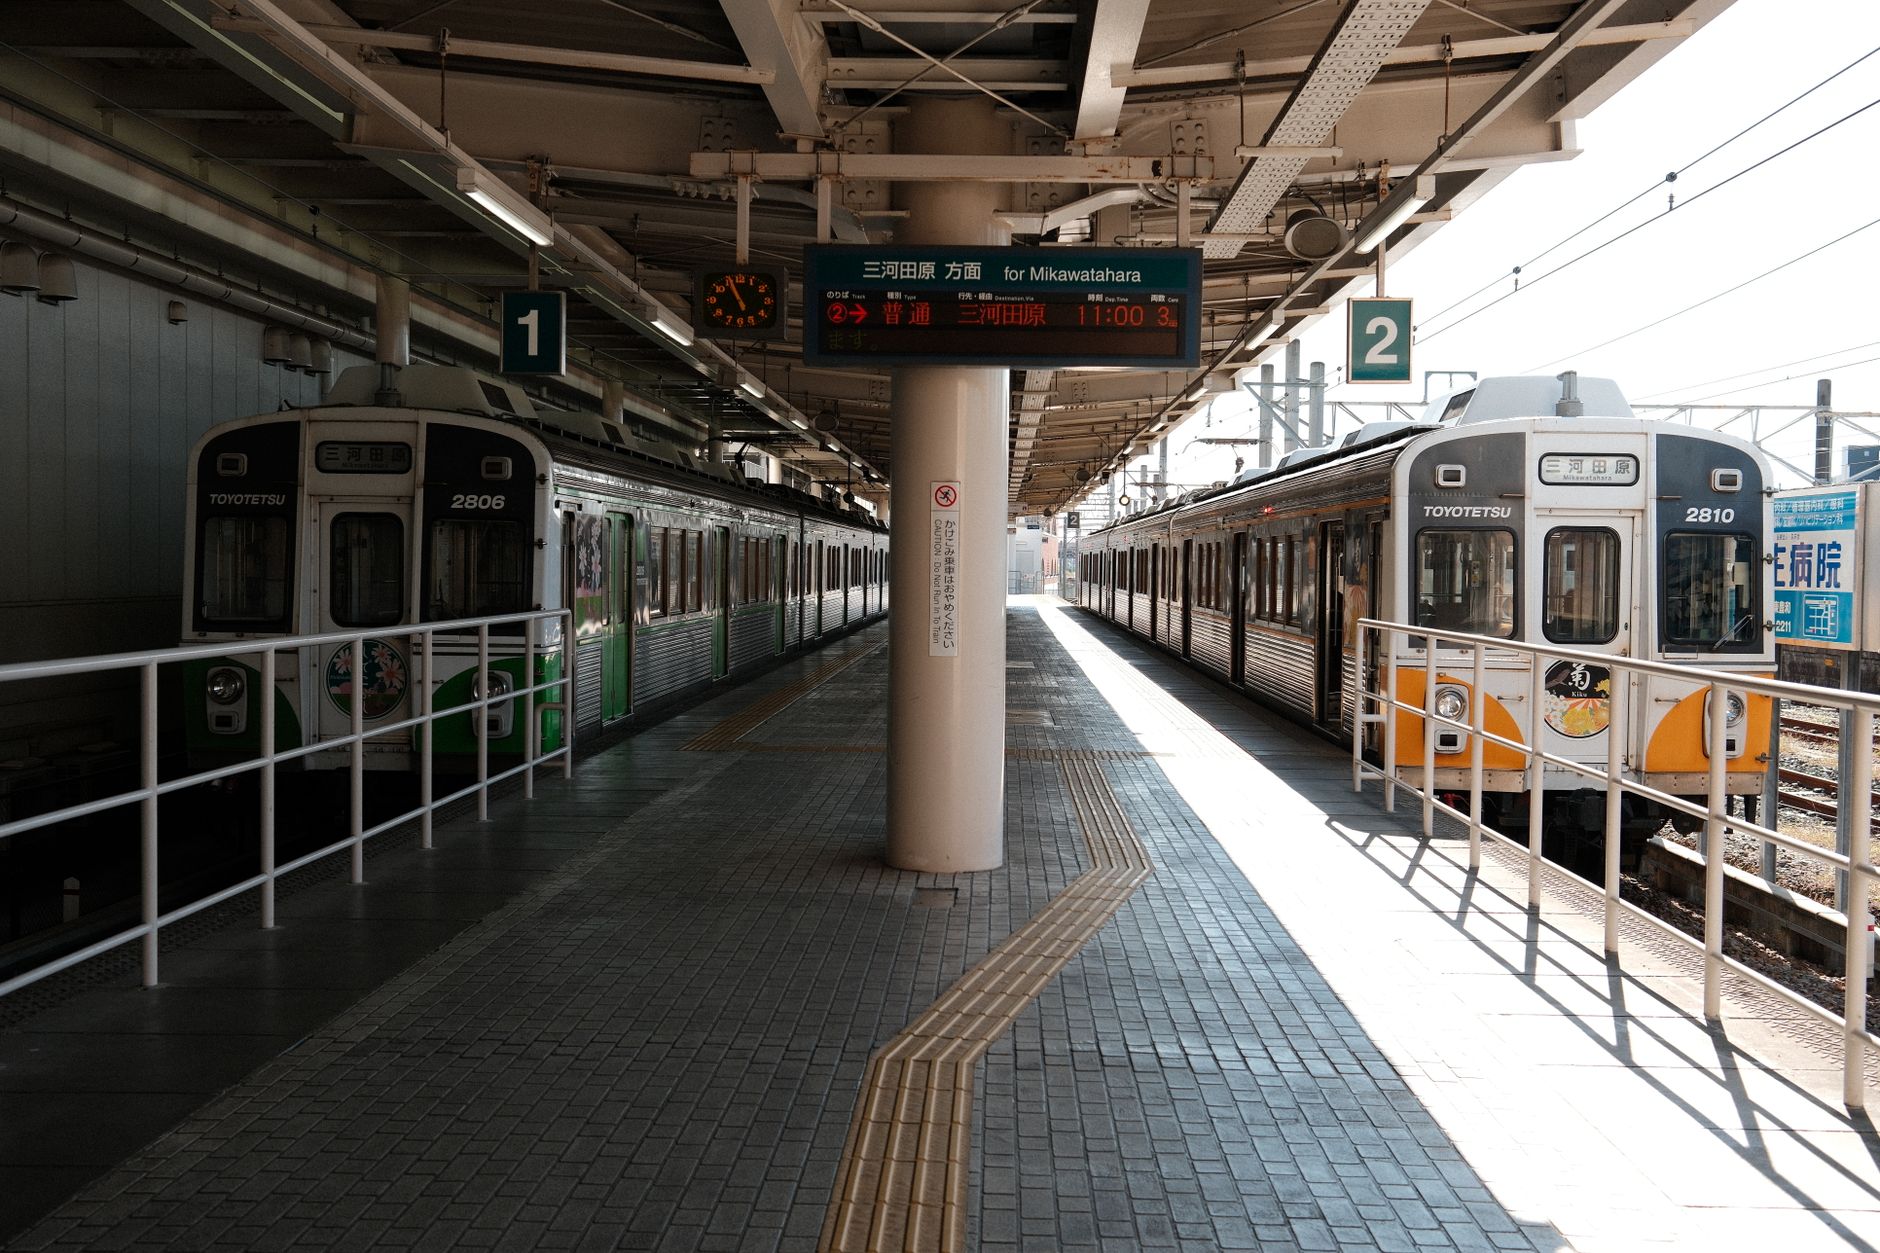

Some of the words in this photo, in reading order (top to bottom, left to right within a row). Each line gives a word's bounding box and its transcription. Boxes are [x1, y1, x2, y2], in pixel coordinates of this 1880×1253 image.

[862, 261, 936, 280] 三河田原
[944, 261, 982, 280] 方面
[1004, 266, 1025, 281] for
[1030, 266, 1141, 283] Mikawatahara
[715, 285, 726, 293] 10
[709, 296, 717, 304] 9
[764, 296, 771, 305] 3
[826, 291, 850, 300] のりば
[1088, 294, 1103, 302] 時刻
[1150, 294, 1166, 302] 両数
[715, 308, 723, 316] 8
[758, 309, 766, 318] 4
[958, 303, 1046, 326] 三河田原
[1078, 304, 1144, 326] 11:00
[726, 315, 733, 323] 7
[736, 317, 744, 326] 6
[748, 316, 756, 324] 5
[518, 309, 539, 357] 1
[1364, 316, 1398, 365] 2
[1546, 458, 1631, 475] 三河田原
[209, 494, 286, 506] TOYOTETSU
[450, 494, 506, 510] 2806
[1423, 506, 1512, 518] TOYOTETSU
[1685, 507, 1736, 524] 2810
[1070, 515, 1078, 525] 2
[934, 519, 942, 556] CAUTION
[934, 562, 941, 572] Do
[944, 520, 956, 648] かけこみ乗車はおやめください
[933, 616, 940, 624] To
